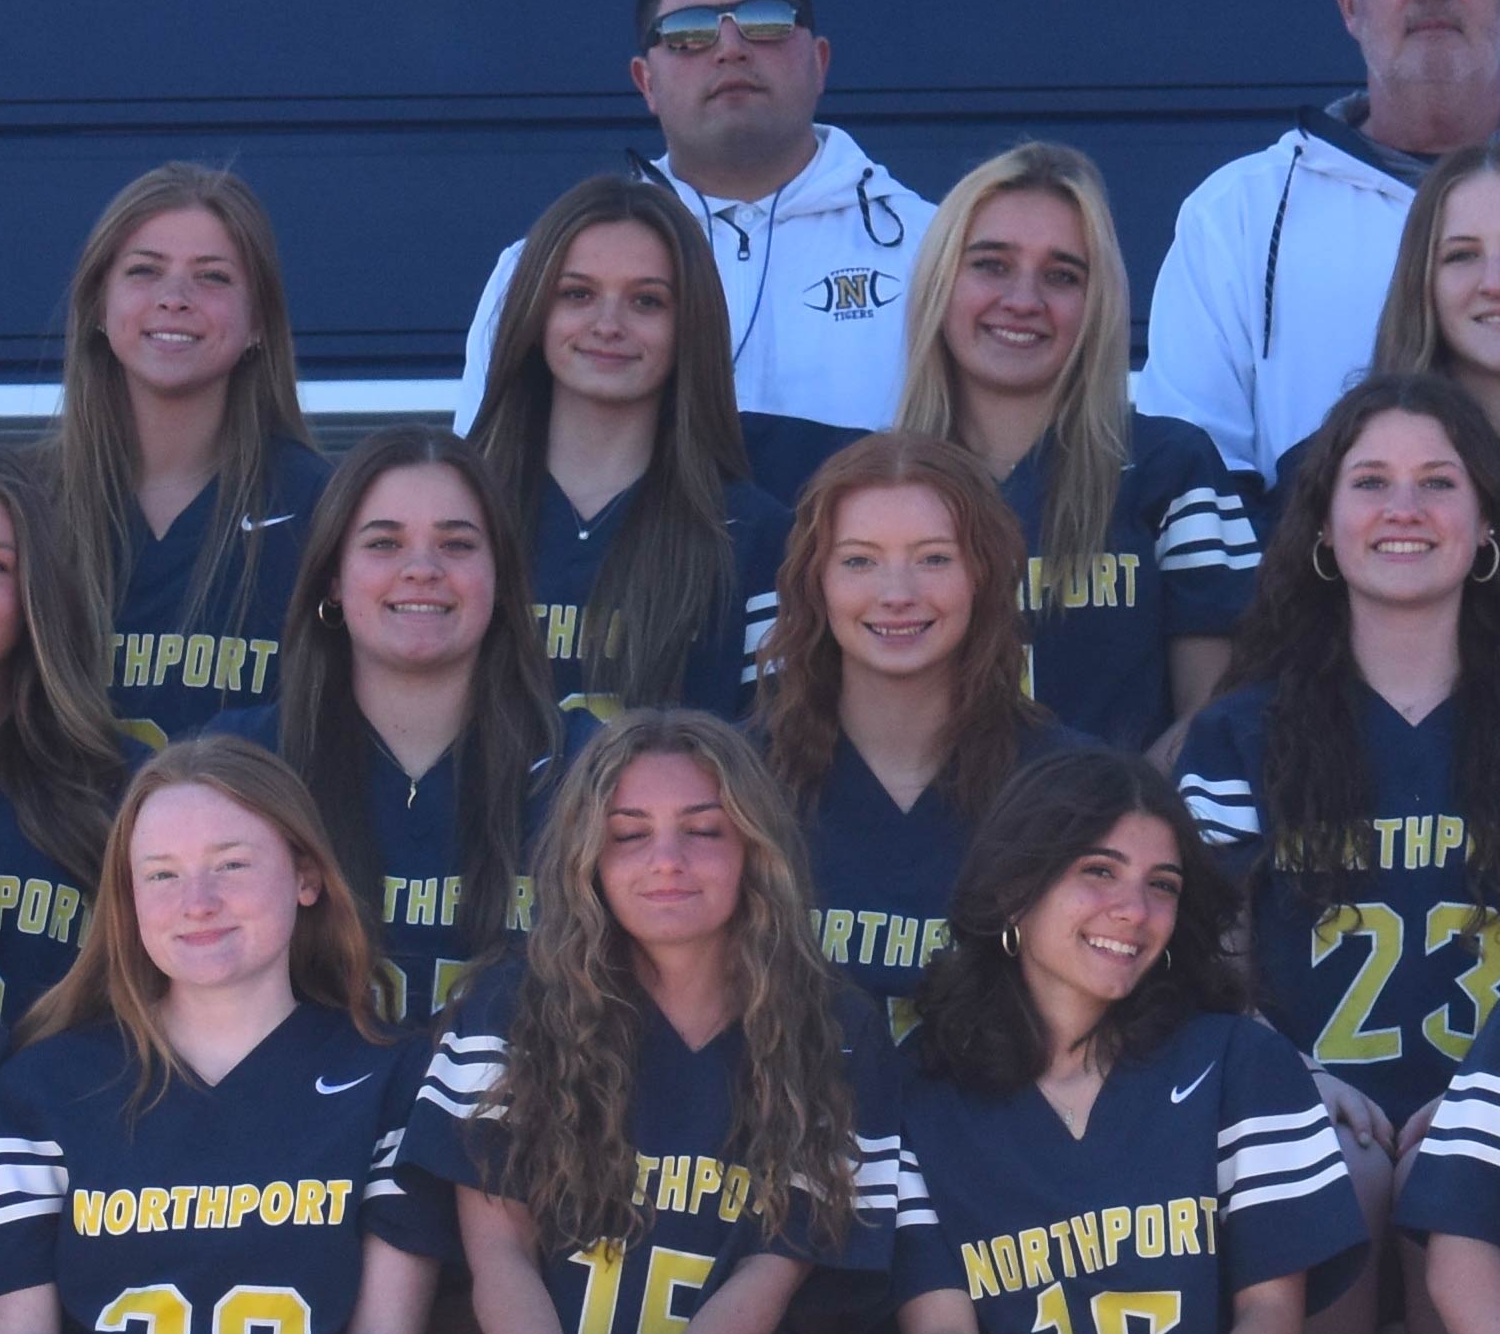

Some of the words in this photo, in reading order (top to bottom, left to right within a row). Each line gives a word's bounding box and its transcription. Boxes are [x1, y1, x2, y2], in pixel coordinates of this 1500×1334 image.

[833, 273, 868, 310] N
[832, 309, 874, 322] TIGERS
[73, 1179, 353, 1237] NORTHPORT
[961, 1196, 1218, 1300] NORTHPORT
